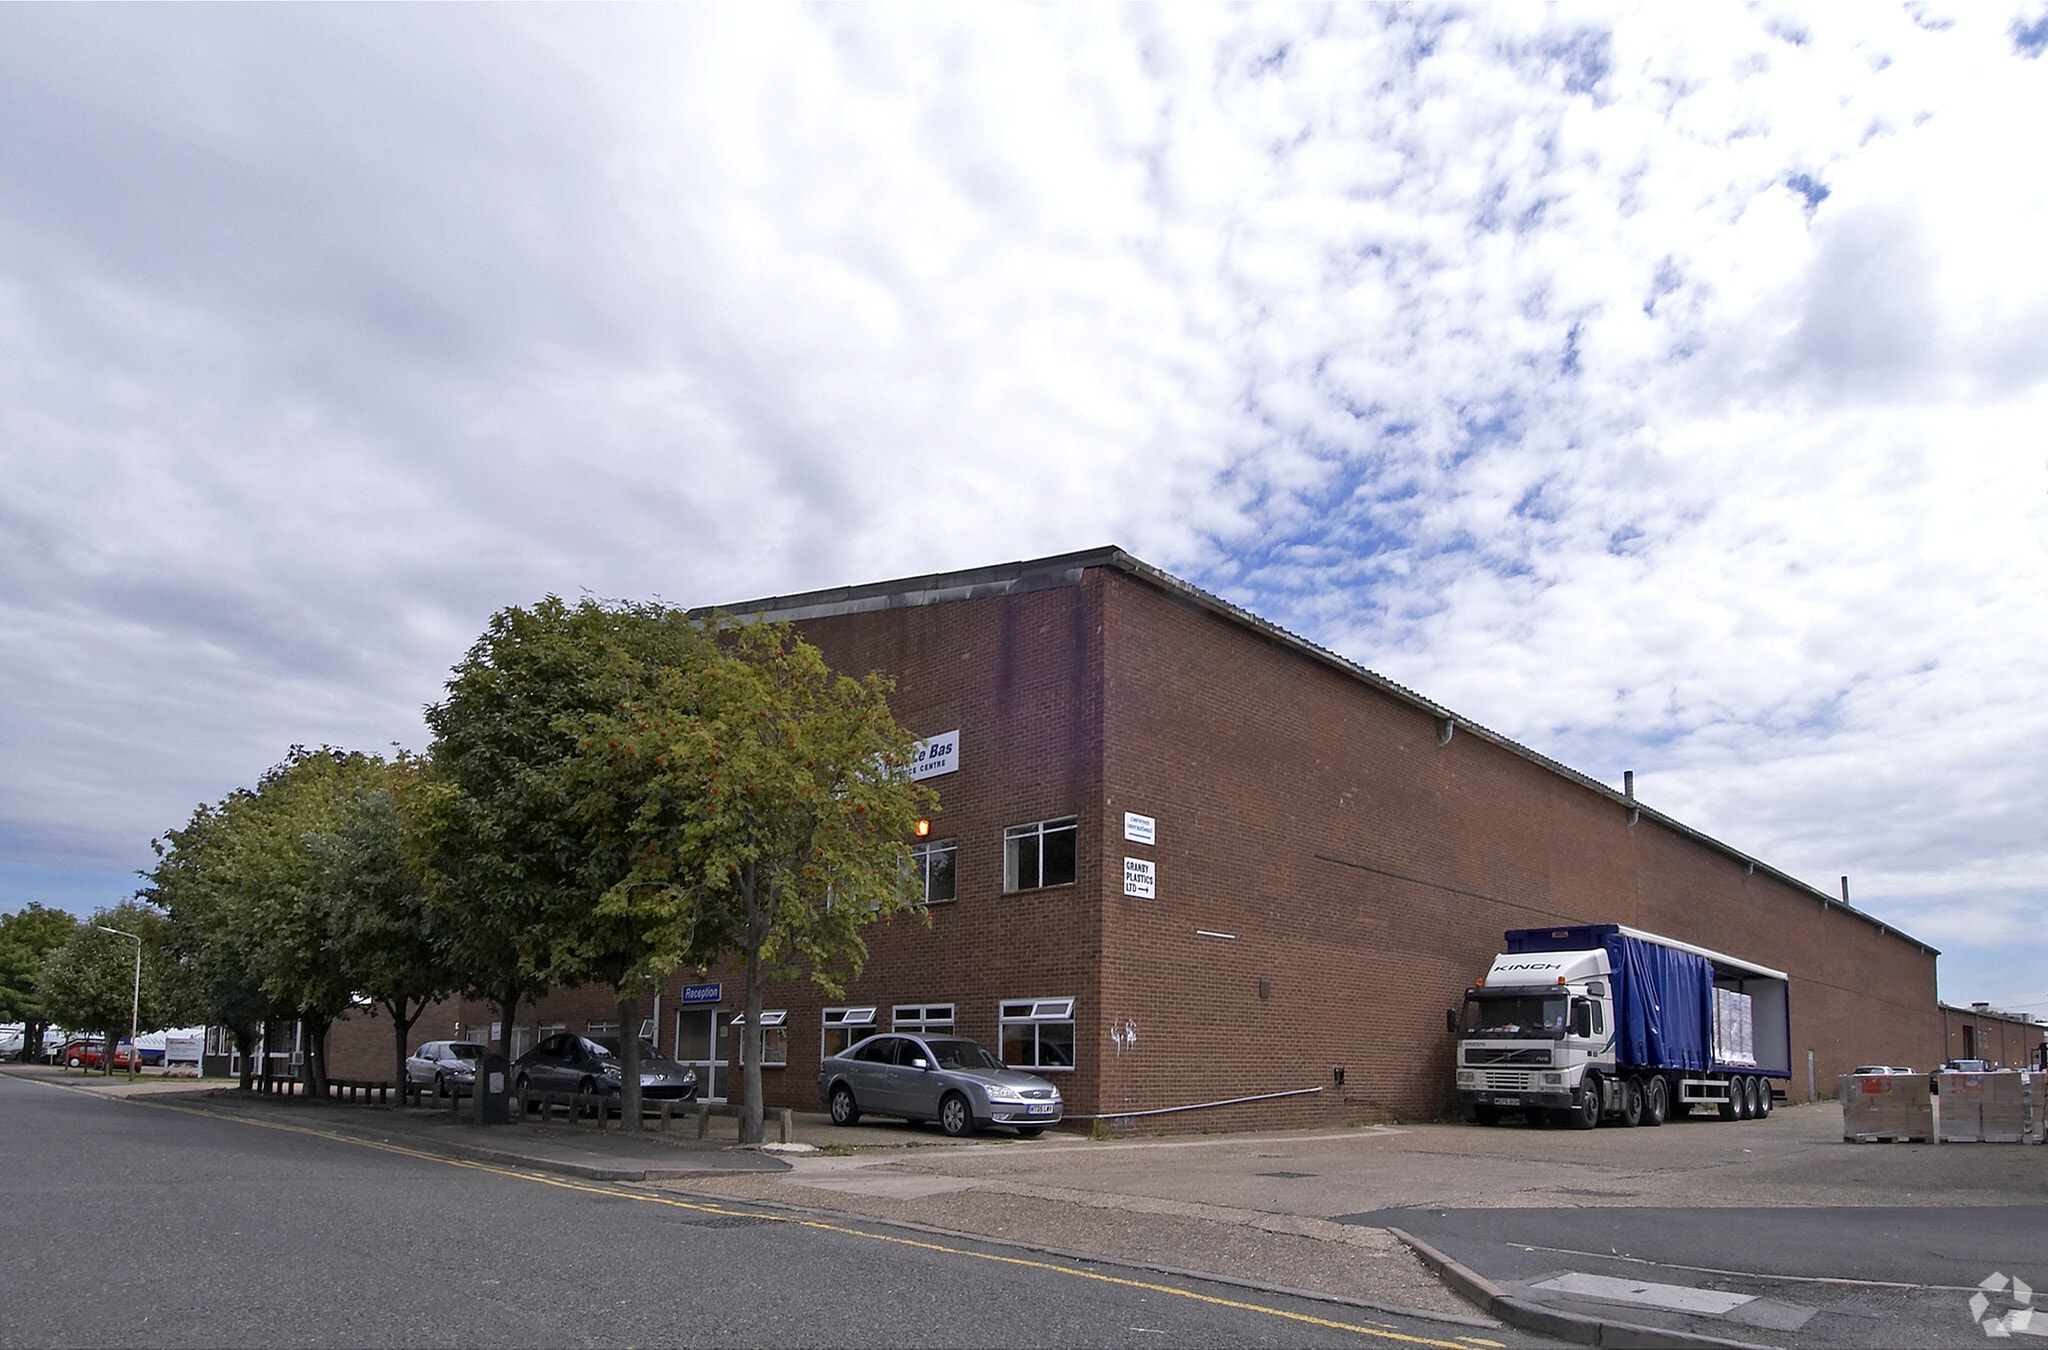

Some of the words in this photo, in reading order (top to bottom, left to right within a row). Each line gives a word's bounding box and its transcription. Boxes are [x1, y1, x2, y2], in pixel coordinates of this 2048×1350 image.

[929, 743, 953, 759] Bas
[920, 759, 946, 772] CENTRE
[1126, 861, 1149, 873] GRANBY
[1126, 872, 1154, 885] PLASTICS
[1126, 883, 1137, 892] LTD
[1494, 963, 1562, 972] KINCH
[685, 986, 718, 1000] Reception
